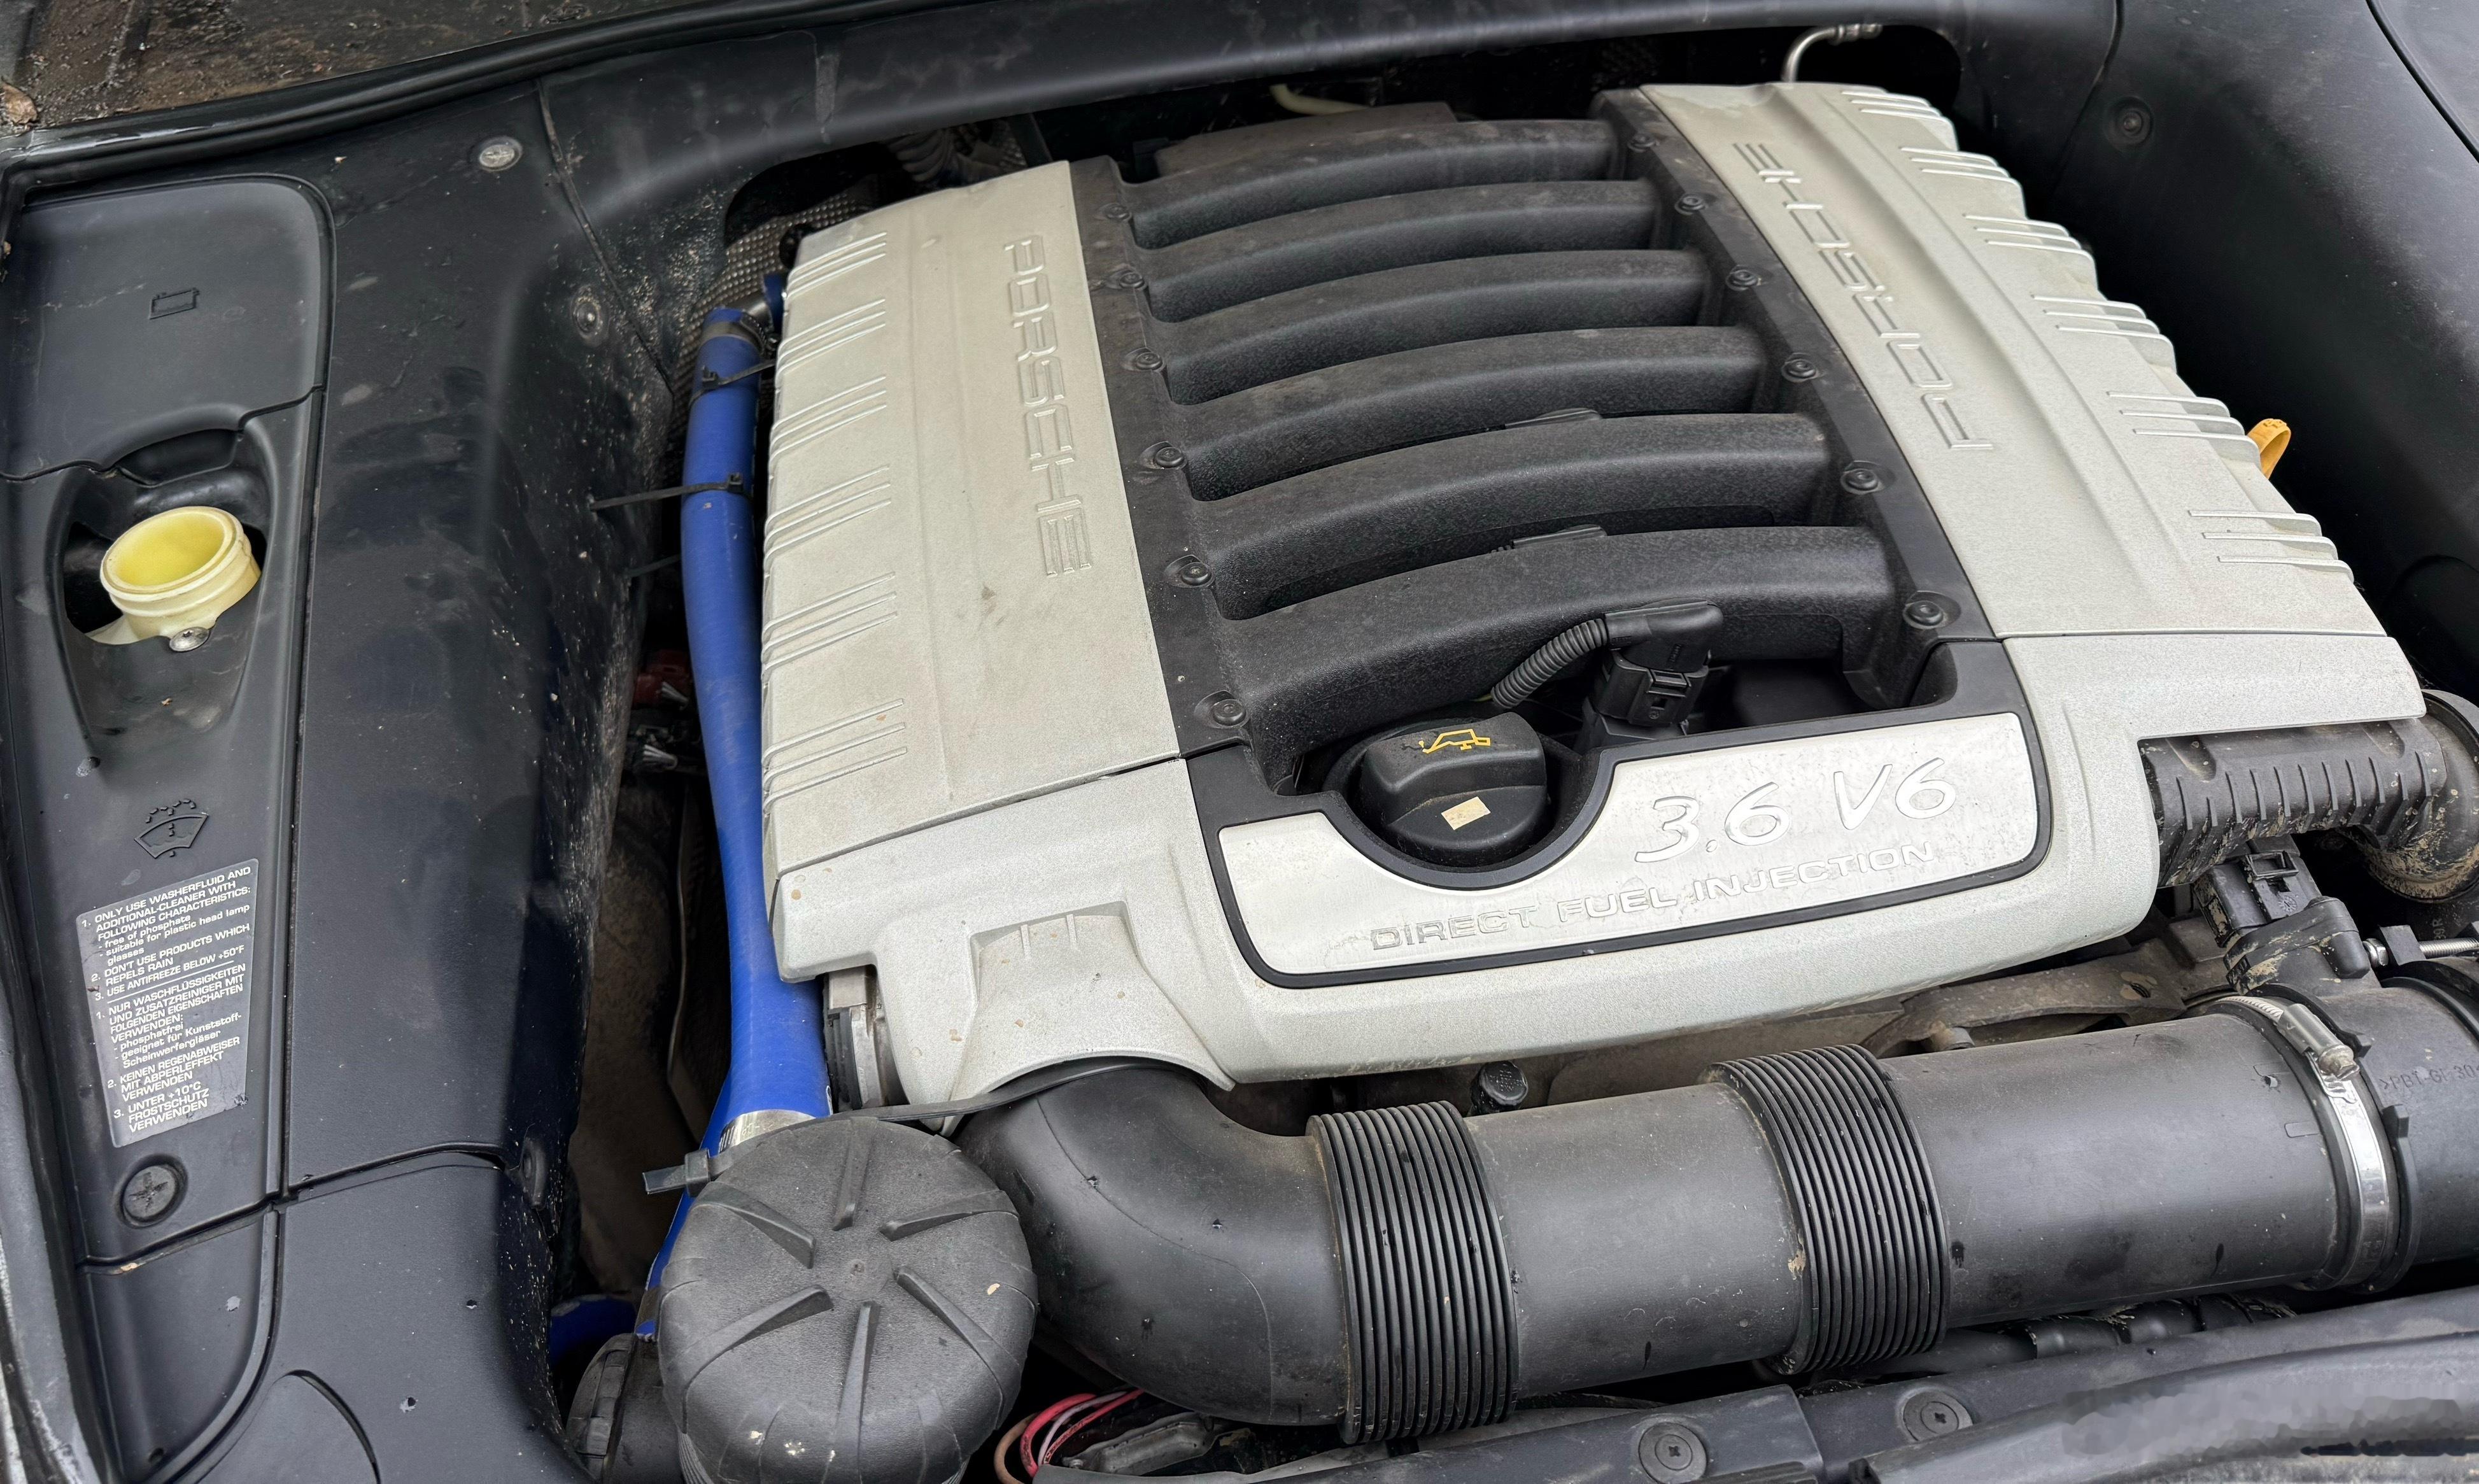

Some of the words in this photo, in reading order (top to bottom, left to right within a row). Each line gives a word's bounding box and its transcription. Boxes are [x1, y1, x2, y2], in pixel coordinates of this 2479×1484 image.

[1733, 143, 1994, 449] PORSCHE
[1004, 234, 1092, 576] PORSCHE
[1634, 781, 1791, 863] 3.6
[1833, 757, 1956, 831] V6
[81, 919, 91, 928] 1.
[95, 907, 124, 923] ONLY
[125, 899, 147, 913] USE
[149, 874, 225, 905] WASHERFLUID
[227, 866, 251, 880] AND
[96, 889, 206, 933] ADDITIONAL-CLEANER
[208, 880, 236, 896] WITH
[98, 915, 157, 942] FOLLOWING
[158, 886, 251, 921] CHARACTERISTICS:
[1370, 905, 1537, 950] DIRECT
[1557, 886, 1677, 923] FUEL
[1693, 841, 1934, 902] INJECTION
[91, 973, 101, 982] 2.
[104, 959, 135, 977] DON'T
[137, 952, 157, 966] USE
[159, 935, 213, 959] PRODUCTS
[215, 922, 250, 941] WHICH
[104, 936, 125, 949] free
[127, 930, 138, 941] of
[139, 915, 192, 938] phosphate
[106, 938, 145, 956] suitable
[146, 932, 162, 943] for
[164, 921, 197, 939] plastic
[199, 910, 223, 926] head
[225, 904, 250, 917] lamp
[95, 992, 104, 1001] 3.
[107, 983, 125, 997] USE
[127, 965, 181, 991] ANTIFREEZE
[183, 953, 216, 972] BELOW
[218, 944, 245, 959] +50°F
[106, 966, 145, 987] REPELS
[148, 956, 174, 973] RAIN
[107, 947, 145, 967] glasses
[95, 1011, 106, 1019] 1.
[108, 1000, 131, 1016] NUR
[133, 963, 246, 1007] WASCHFLÜSSIGKEITEN
[109, 1010, 133, 1026] UND
[136, 980, 223, 1017] ZUSATZREINIGER
[225, 973, 245, 987] MIT
[110, 1008, 166, 1035] FOLGENDEN
[167, 983, 243, 1015] EIGENSCHAFTEN
[111, 1013, 183, 1044] VERWENDEN:
[120, 1021, 183, 1052] phosphatfrei
[121, 1038, 165, 1061] geeignet
[167, 1032, 183, 1043] für
[185, 1011, 242, 1038] Kunststoff-
[123, 1029, 222, 1070] Scheinwerfergläser
[107, 1078, 117, 1089] 2.
[120, 1064, 156, 1084] KEINEN
[158, 1035, 241, 1071] REGENABWEISER
[121, 1078, 141, 1094] MIT
[143, 1050, 224, 1085] ABPERLEFFEKT
[122, 1070, 194, 1103] VERWENDEN
[113, 1108, 124, 1119] 3.
[128, 1092, 166, 1113] UNTER
[167, 1080, 202, 1099] +10°C
[129, 1088, 210, 1124] FROSTSCHUTZ
[129, 1098, 209, 1134] VERWENDEN
